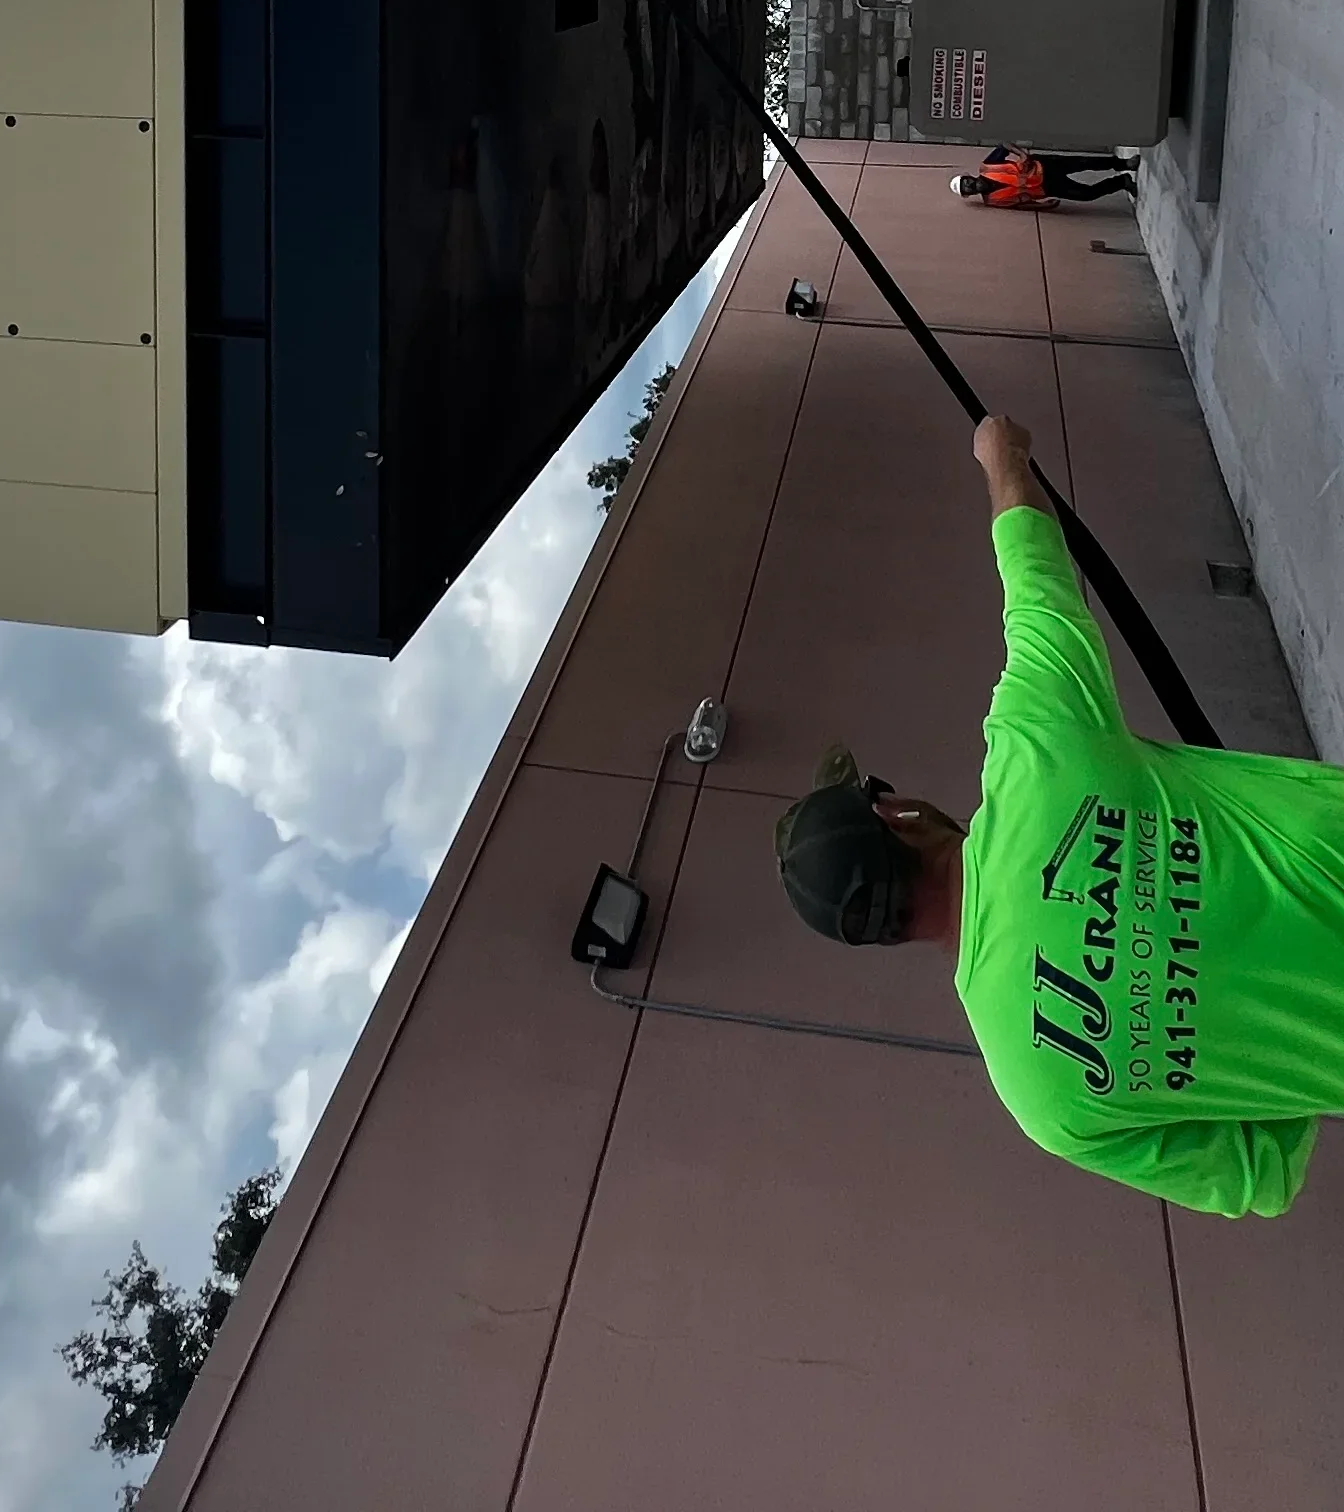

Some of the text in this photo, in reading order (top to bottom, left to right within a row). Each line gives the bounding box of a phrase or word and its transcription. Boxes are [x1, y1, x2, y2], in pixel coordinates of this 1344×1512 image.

[933, 51, 945, 116] NO SMOKING
[953, 51, 964, 117] COMBUSTIBLE
[973, 52, 984, 119] DIESEL
[1032, 804, 1126, 1096] JJ CRANE
[1128, 809, 1157, 1092] 50 YEARS OF SERVICE
[1164, 816, 1200, 1091] 941-371-1184
